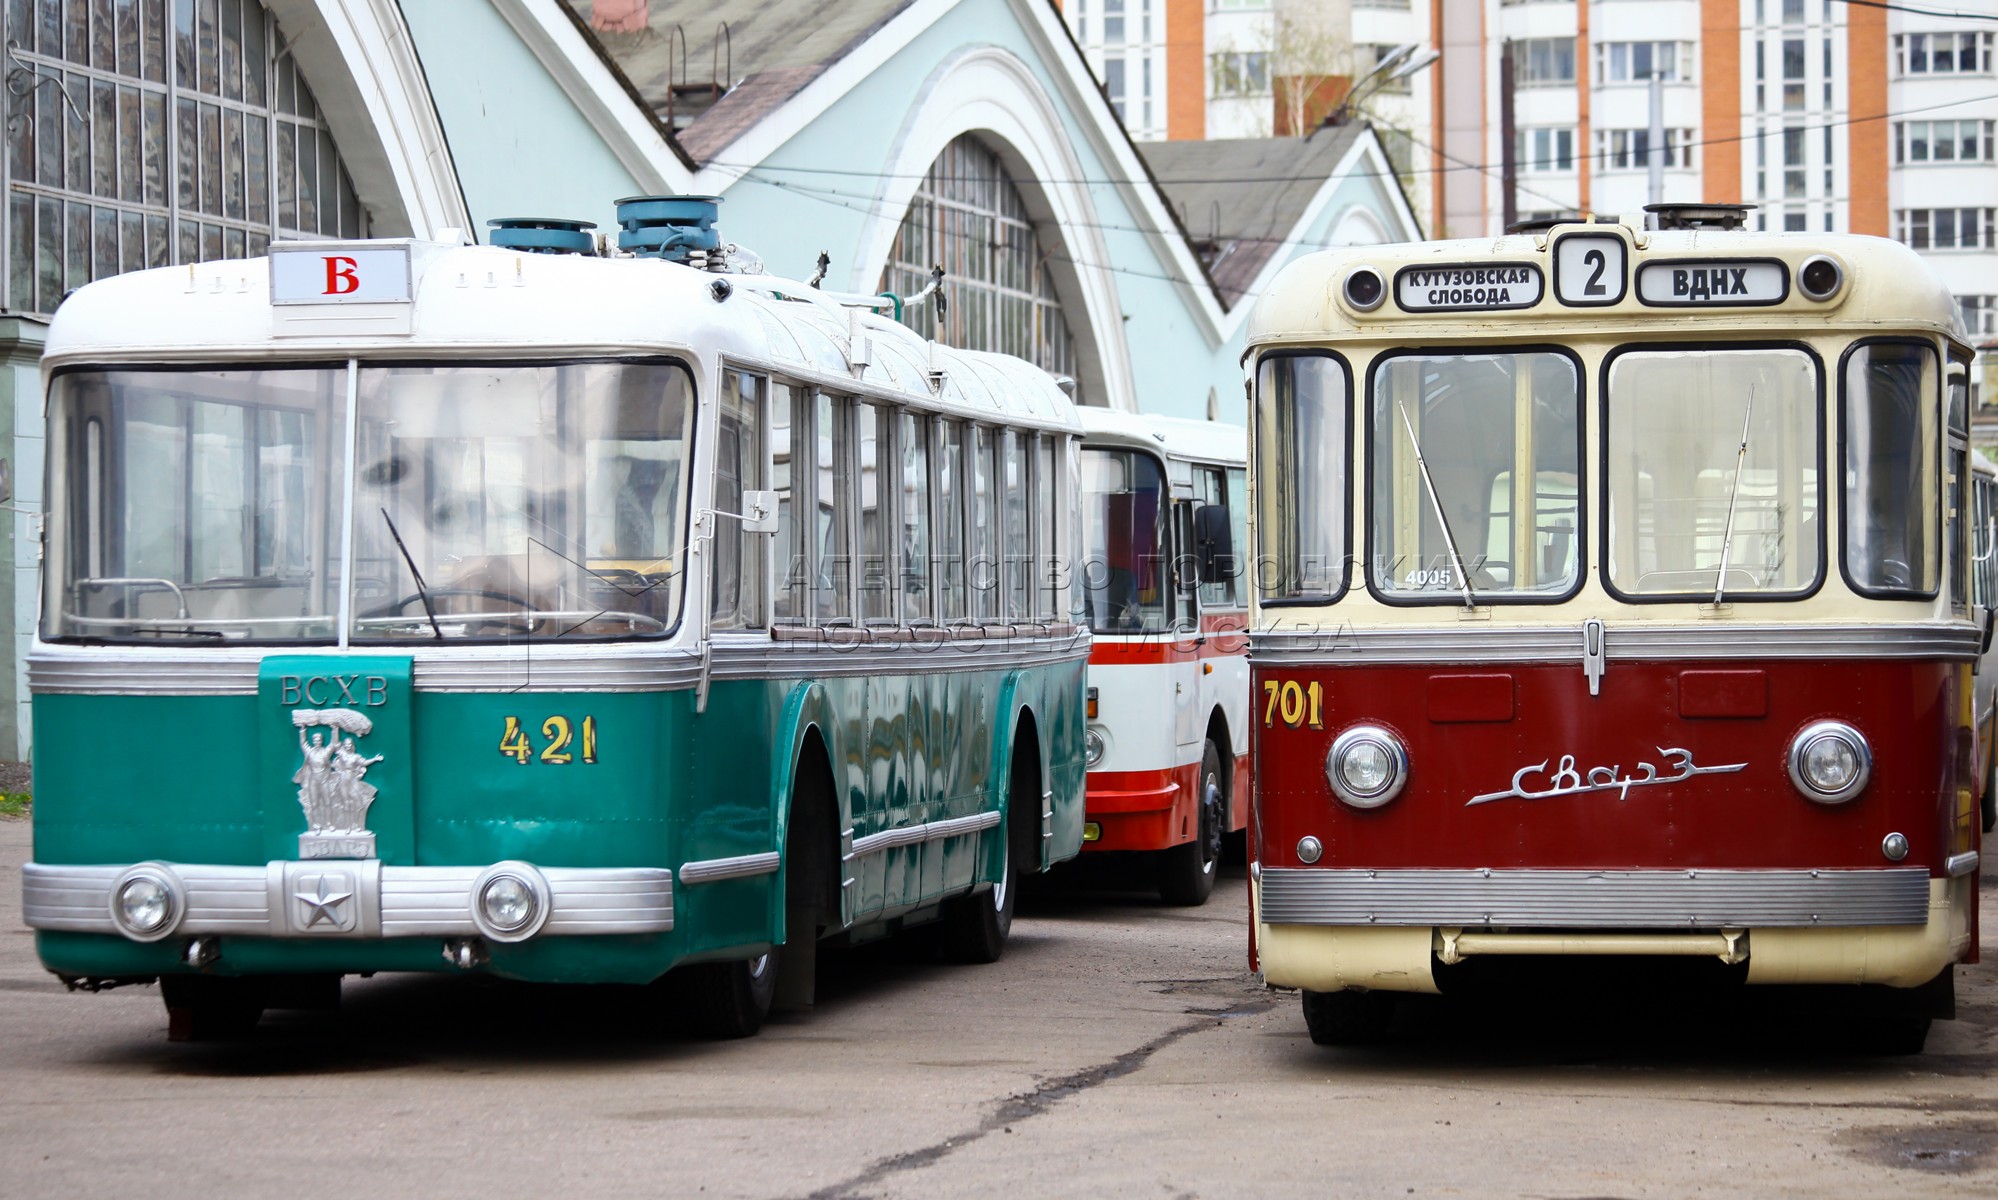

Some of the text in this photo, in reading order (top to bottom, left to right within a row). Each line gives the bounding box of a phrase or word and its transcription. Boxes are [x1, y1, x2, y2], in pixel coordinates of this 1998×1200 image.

[321, 256, 360, 295] В
[1409, 268, 1530, 288] КУТУЗОВСКАЯ
[1583, 249, 1607, 296] 2
[1672, 268, 1749, 300] ВДНХ
[1427, 287, 1511, 306] СЛОБОДА
[1404, 569, 1451, 585] 4005
[280, 674, 388, 706] ВСХВ
[1264, 680, 1324, 731] 701
[499, 715, 598, 764] 421
